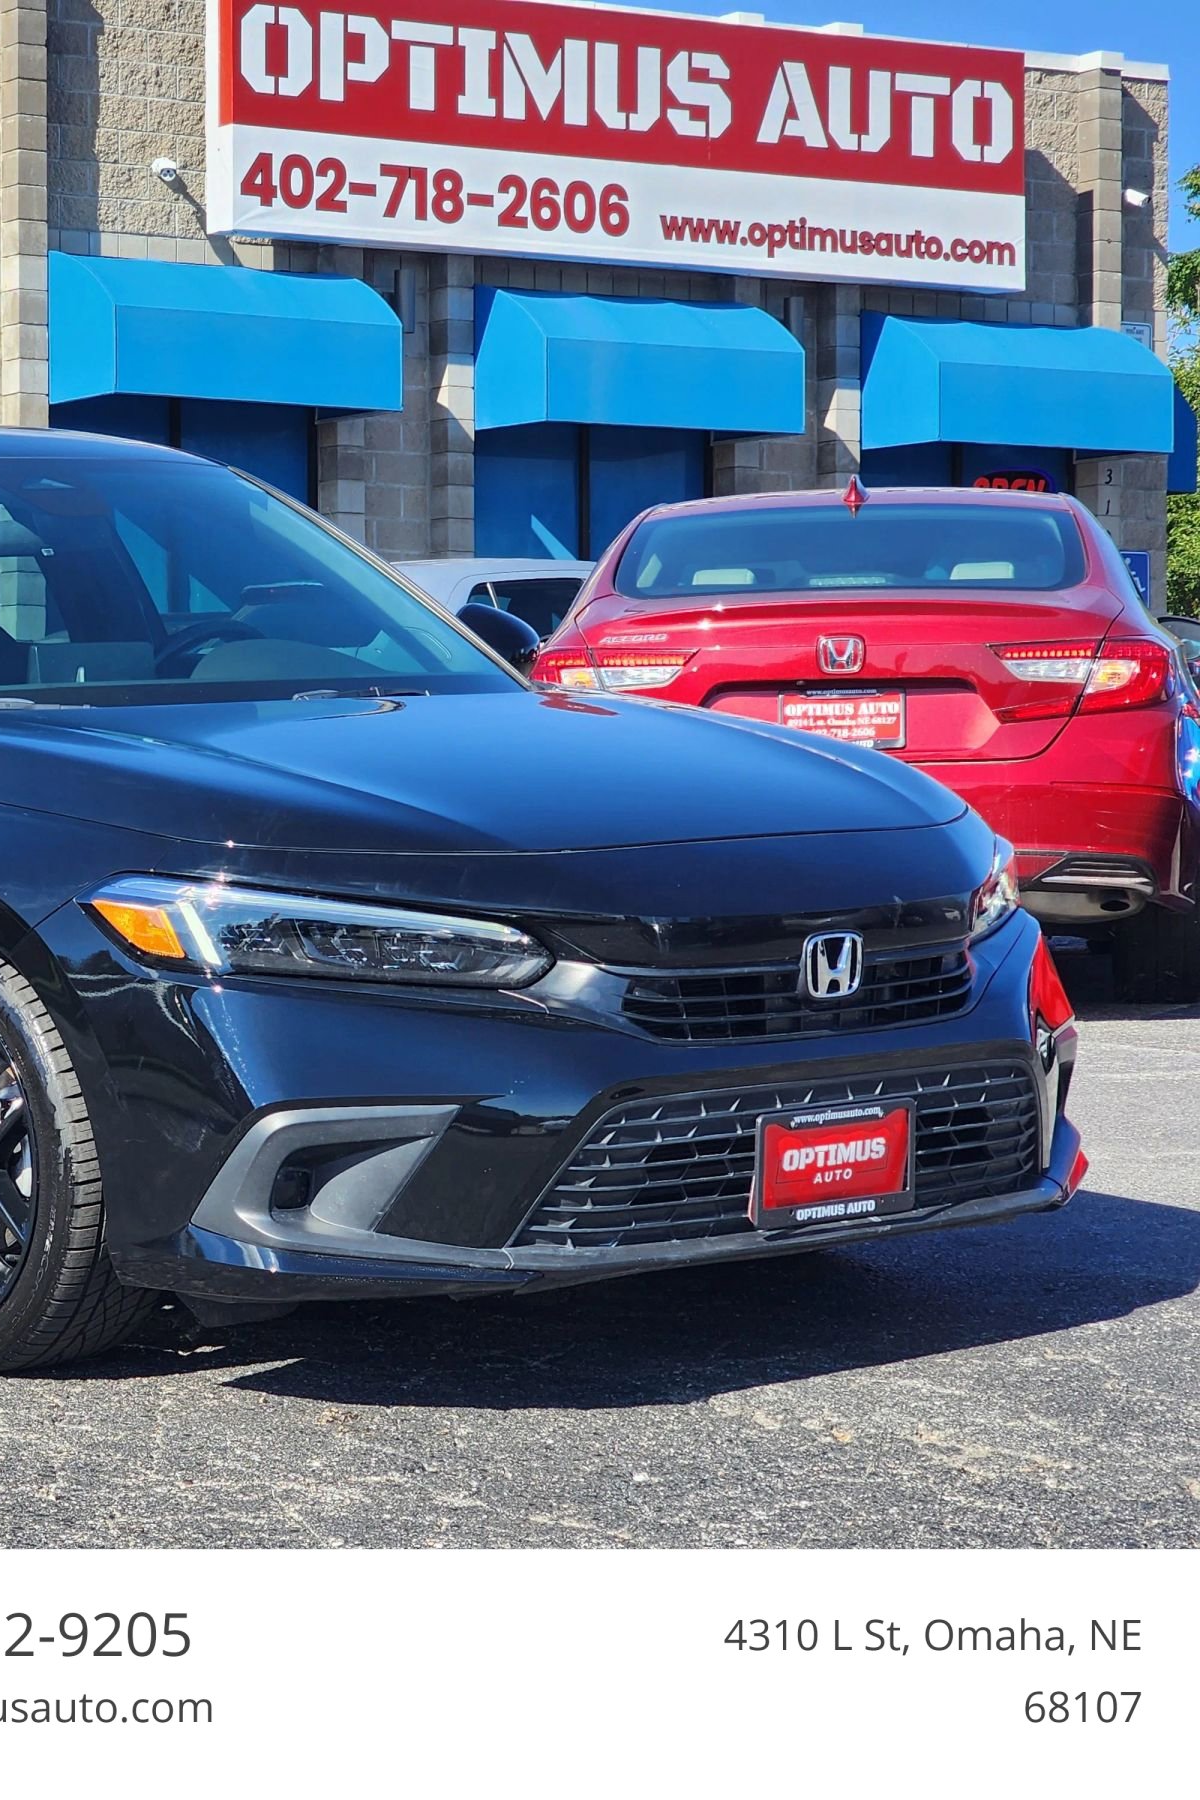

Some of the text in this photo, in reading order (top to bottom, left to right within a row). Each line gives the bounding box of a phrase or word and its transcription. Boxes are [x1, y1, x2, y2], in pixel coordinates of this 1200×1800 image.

[241, 4, 1014, 164] OPTIMUS AUTO
[240, 152, 630, 237] 402-718-2606
[659, 214, 1016, 266] www.optimusauto.com
[599, 633, 668, 644] ACCORD
[785, 702, 900, 716] OPTIMUS AUTO
[794, 1106, 882, 1124] www.optimusauto.com
[782, 1137, 886, 1172] OPTIMUS
[813, 1168, 853, 1184] AUTO
[796, 1200, 876, 1221] OPTIMUS AUTO
